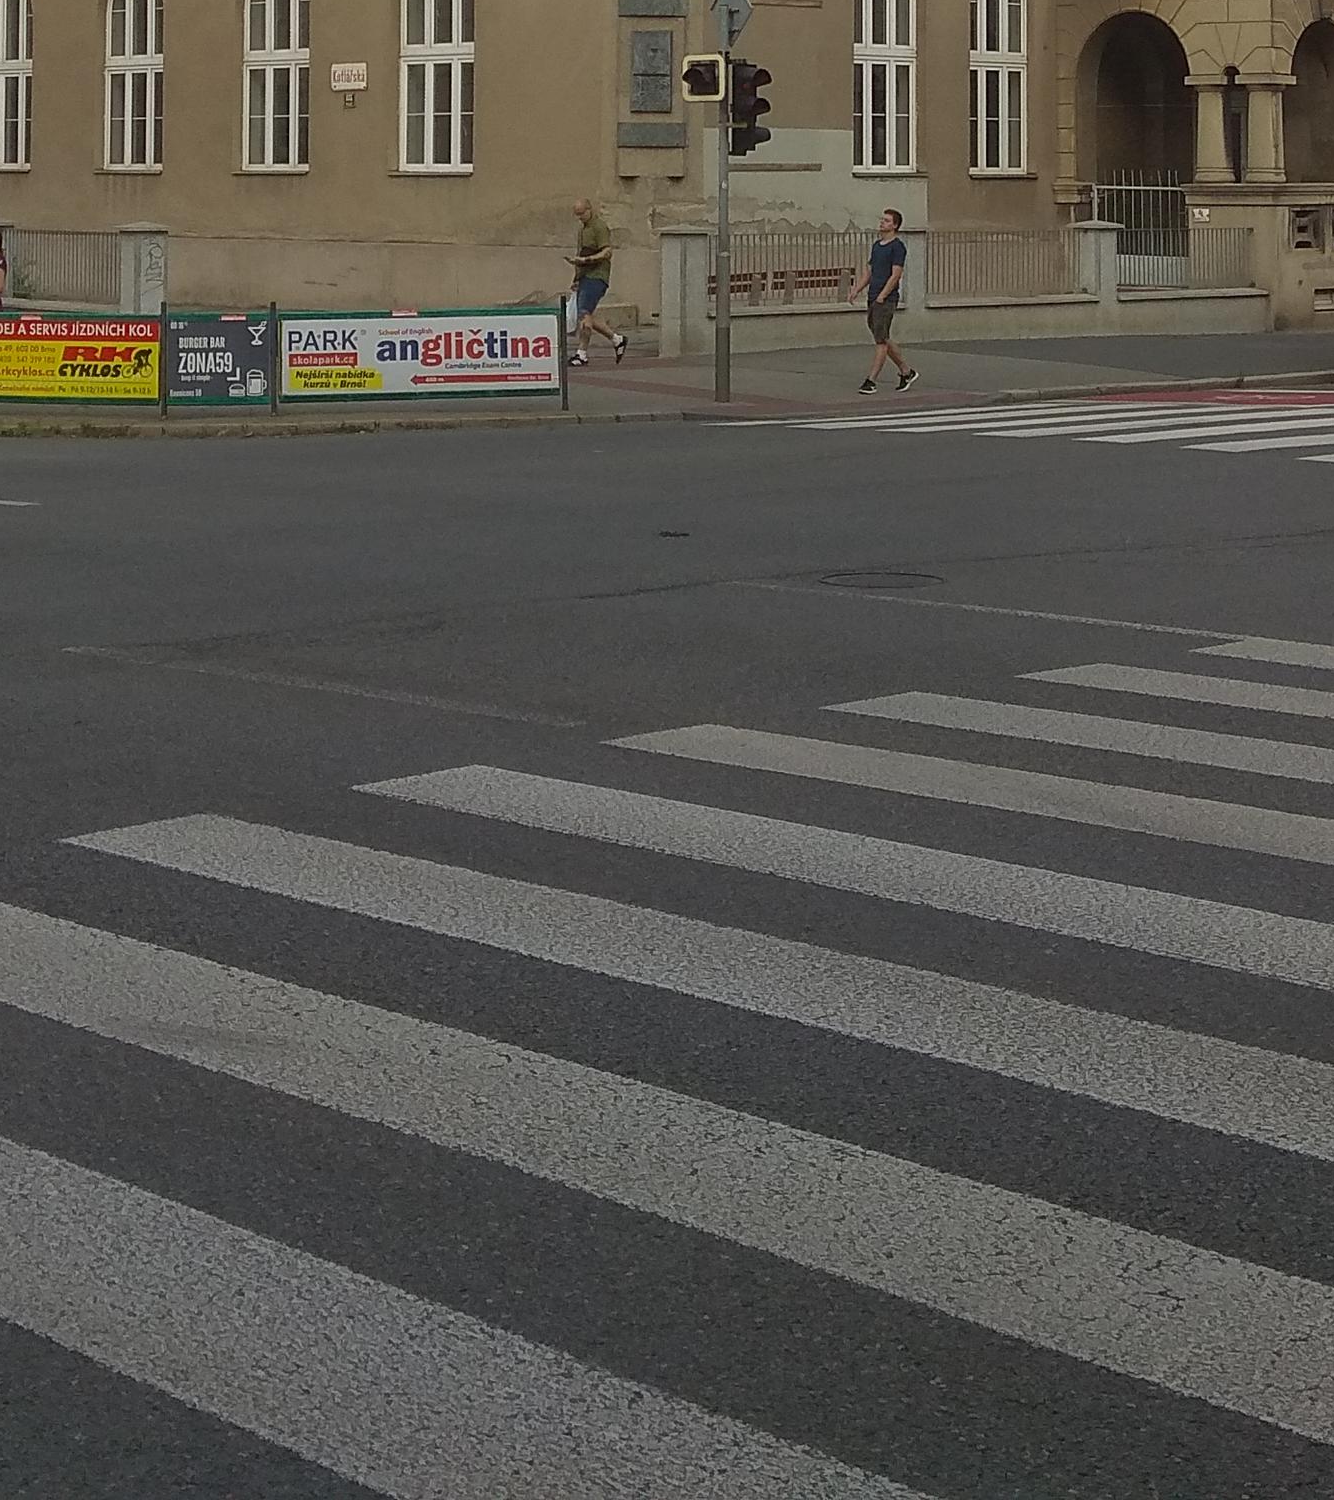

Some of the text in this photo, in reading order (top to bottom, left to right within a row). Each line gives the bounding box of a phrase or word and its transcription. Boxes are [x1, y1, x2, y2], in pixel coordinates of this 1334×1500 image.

[17, 323, 27, 335] A
[29, 323, 68, 336] SERVIS
[70, 320, 126, 337] JÍZDNÍCH
[129, 324, 153, 337] KOL
[409, 328, 433, 337] English
[178, 336, 225, 349] BURGER BAR
[375, 328, 552, 367] angličtina
[61, 345, 139, 363] RK
[58, 363, 123, 378] CYKLOS
[444, 362, 481, 371] Cambridge
[334, 369, 375, 379] nabídka
